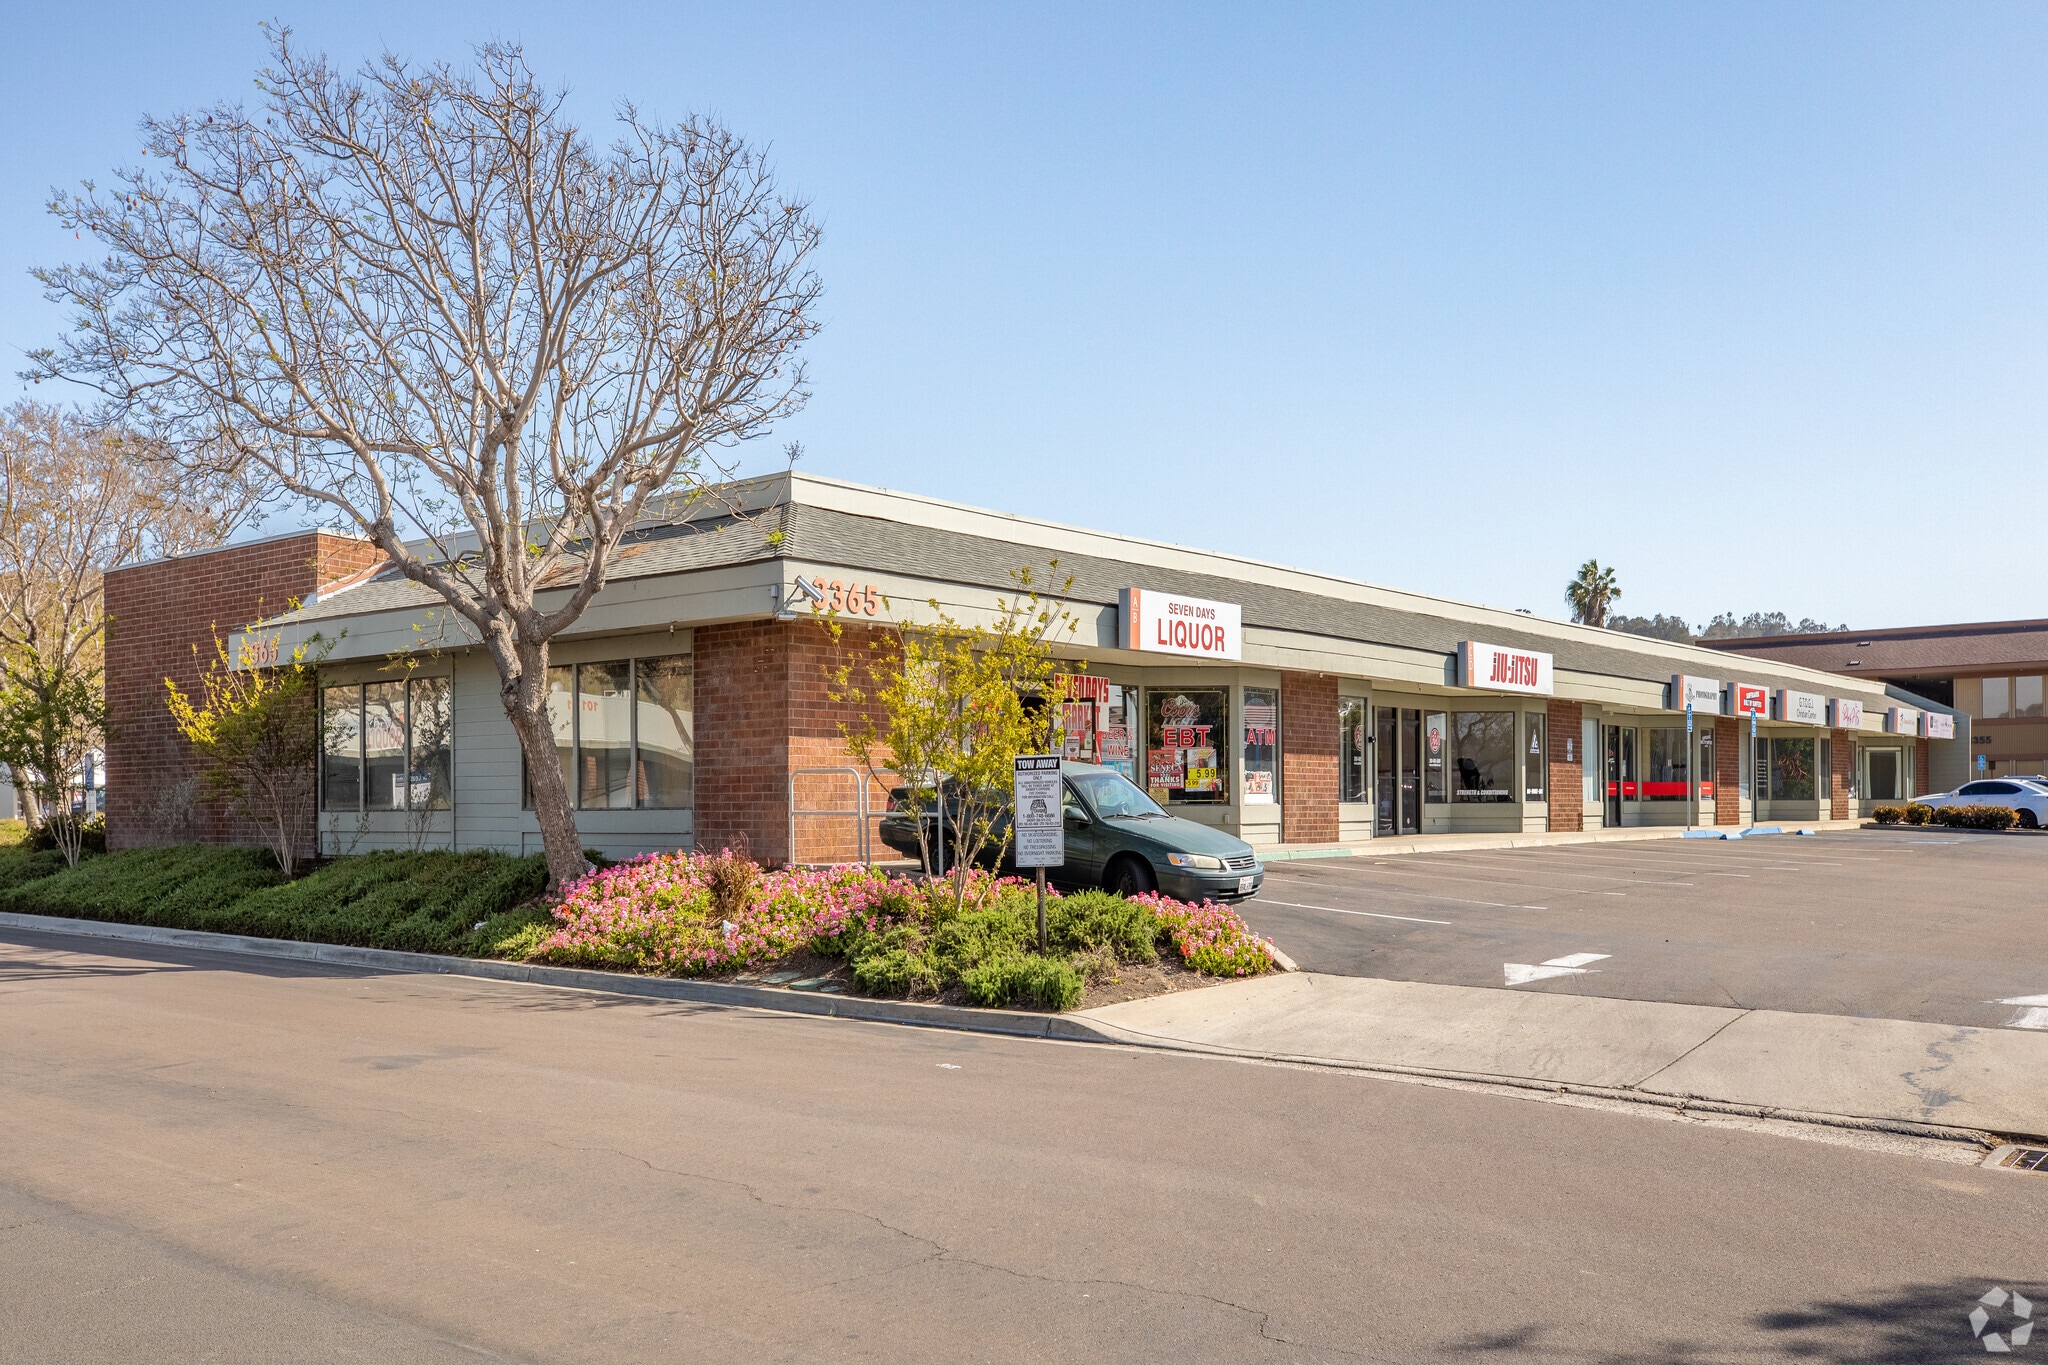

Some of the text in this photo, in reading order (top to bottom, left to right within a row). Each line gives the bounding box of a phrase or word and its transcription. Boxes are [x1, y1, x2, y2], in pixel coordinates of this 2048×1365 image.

[811, 577, 879, 616] 3365
[1132, 596, 1138, 607] A
[1132, 612, 1138, 623] B
[1168, 602, 1216, 620] SEVEN DAYS
[1157, 618, 1225, 652] LIQUOR
[1085, 677, 1109, 703] DAYS
[1062, 703, 1101, 730] MARKT
[1102, 729, 1125, 740] BEER
[1163, 728, 1210, 748] EBT
[1246, 728, 1275, 745] ATM
[1108, 744, 1129, 756] WINE
[1017, 759, 1058, 769] TOW AWAY
[1196, 768, 1216, 779] 5.99
